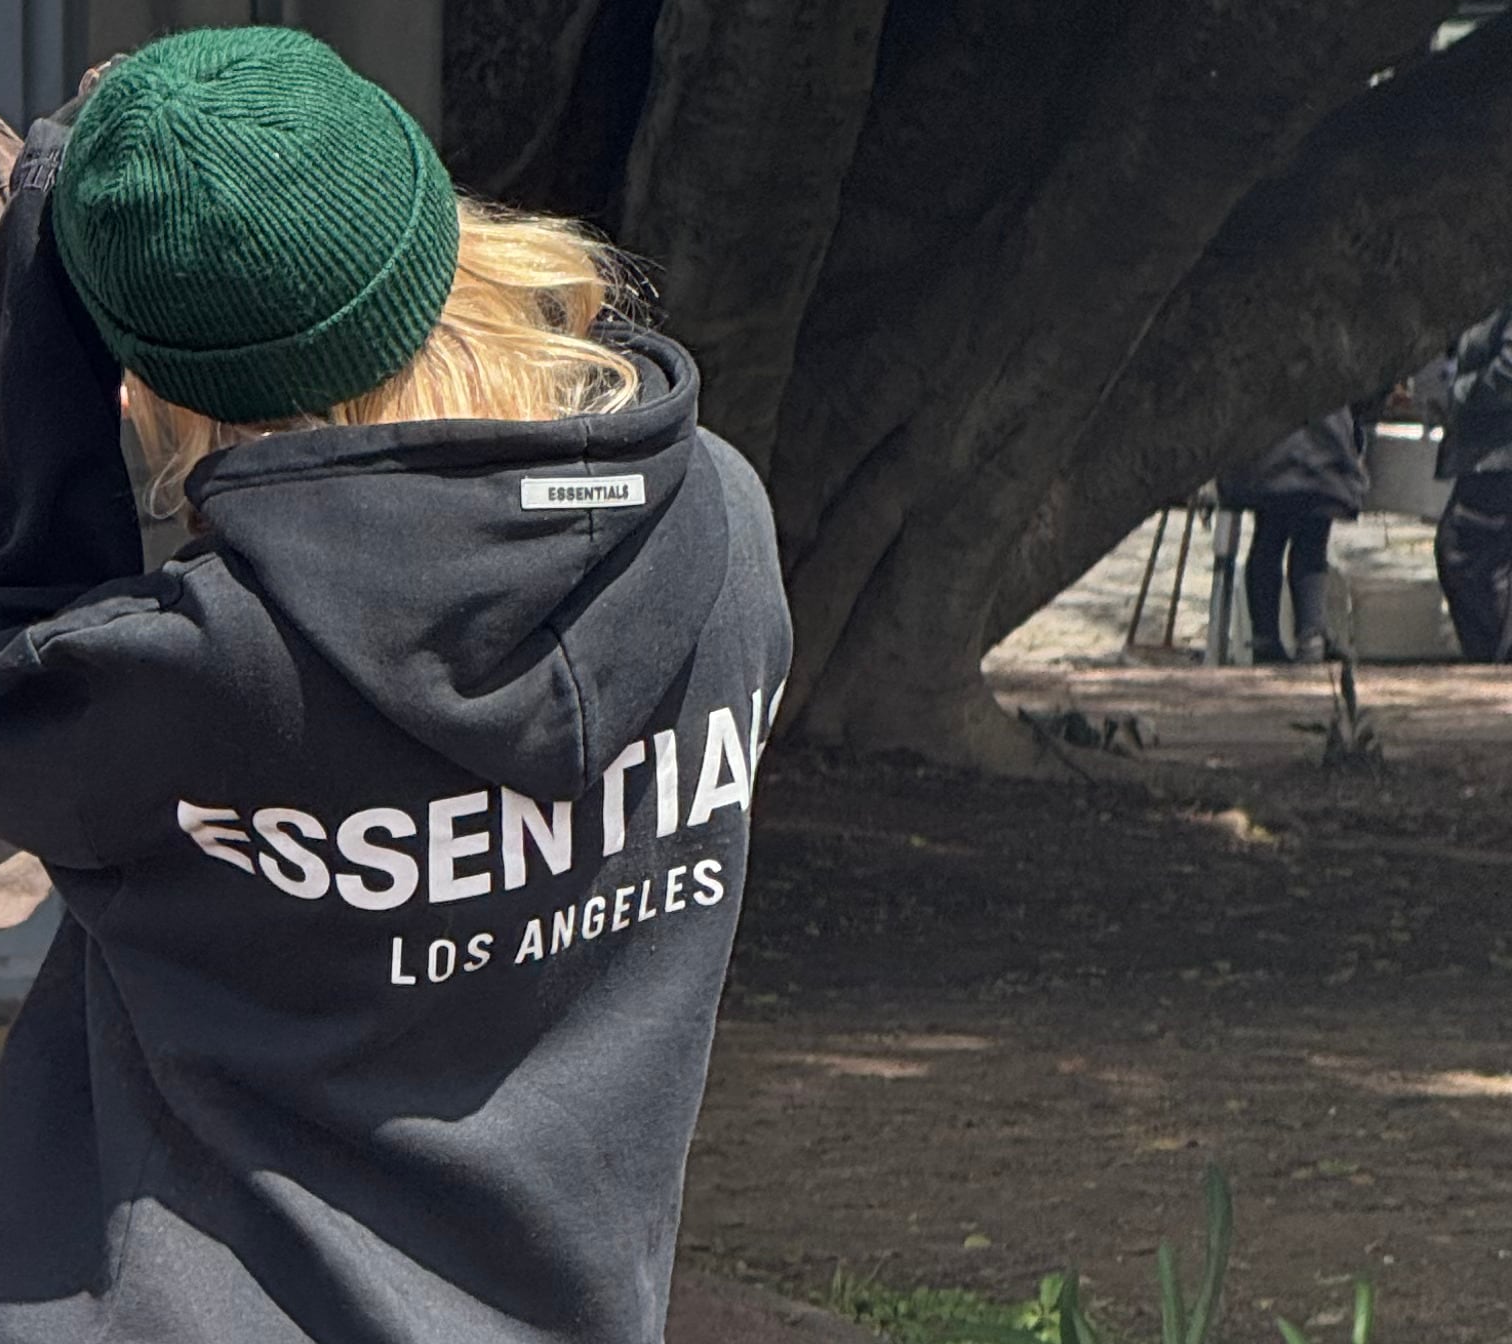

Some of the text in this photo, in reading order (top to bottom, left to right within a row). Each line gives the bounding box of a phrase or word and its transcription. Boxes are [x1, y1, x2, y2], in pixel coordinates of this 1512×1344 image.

[547, 483, 630, 502] ESSENTIALS
[177, 677, 786, 911] ESSENTIA
[390, 859, 725, 986] LOS ANGELES
